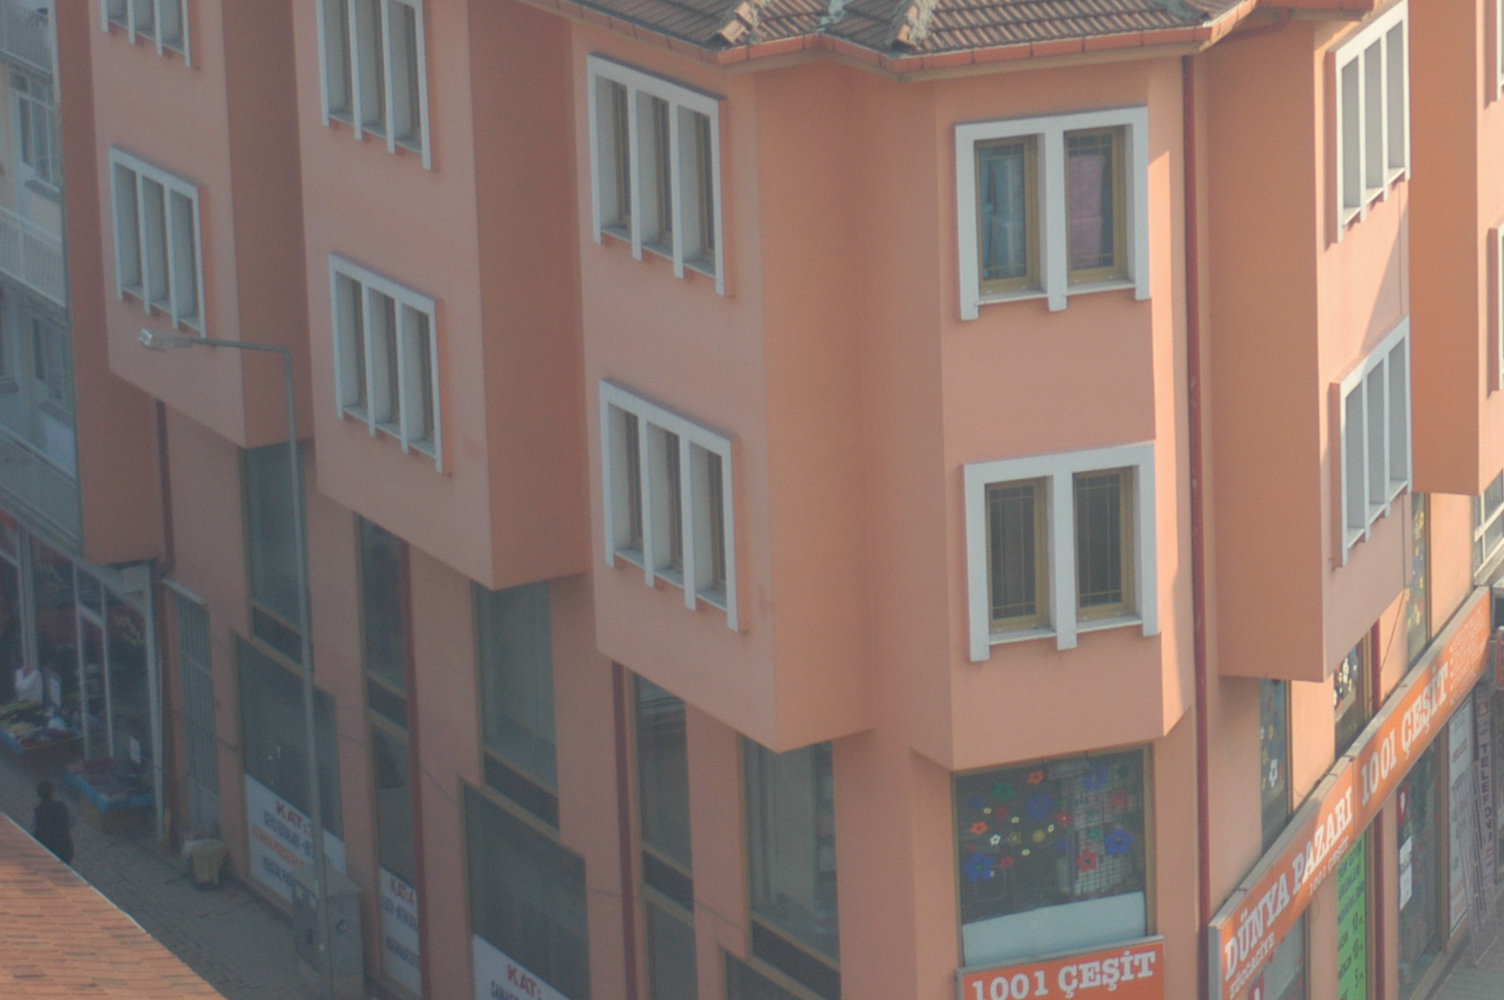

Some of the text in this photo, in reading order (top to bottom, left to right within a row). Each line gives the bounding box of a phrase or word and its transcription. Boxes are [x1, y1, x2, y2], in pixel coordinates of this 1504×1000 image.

[1361, 662, 1449, 806] 1001 ÇEŞİT
[1224, 872, 1291, 981] DÜNYA
[1291, 786, 1354, 895] PAZARI
[972, 950, 1156, 1000] 1001 ÇEŞİT
